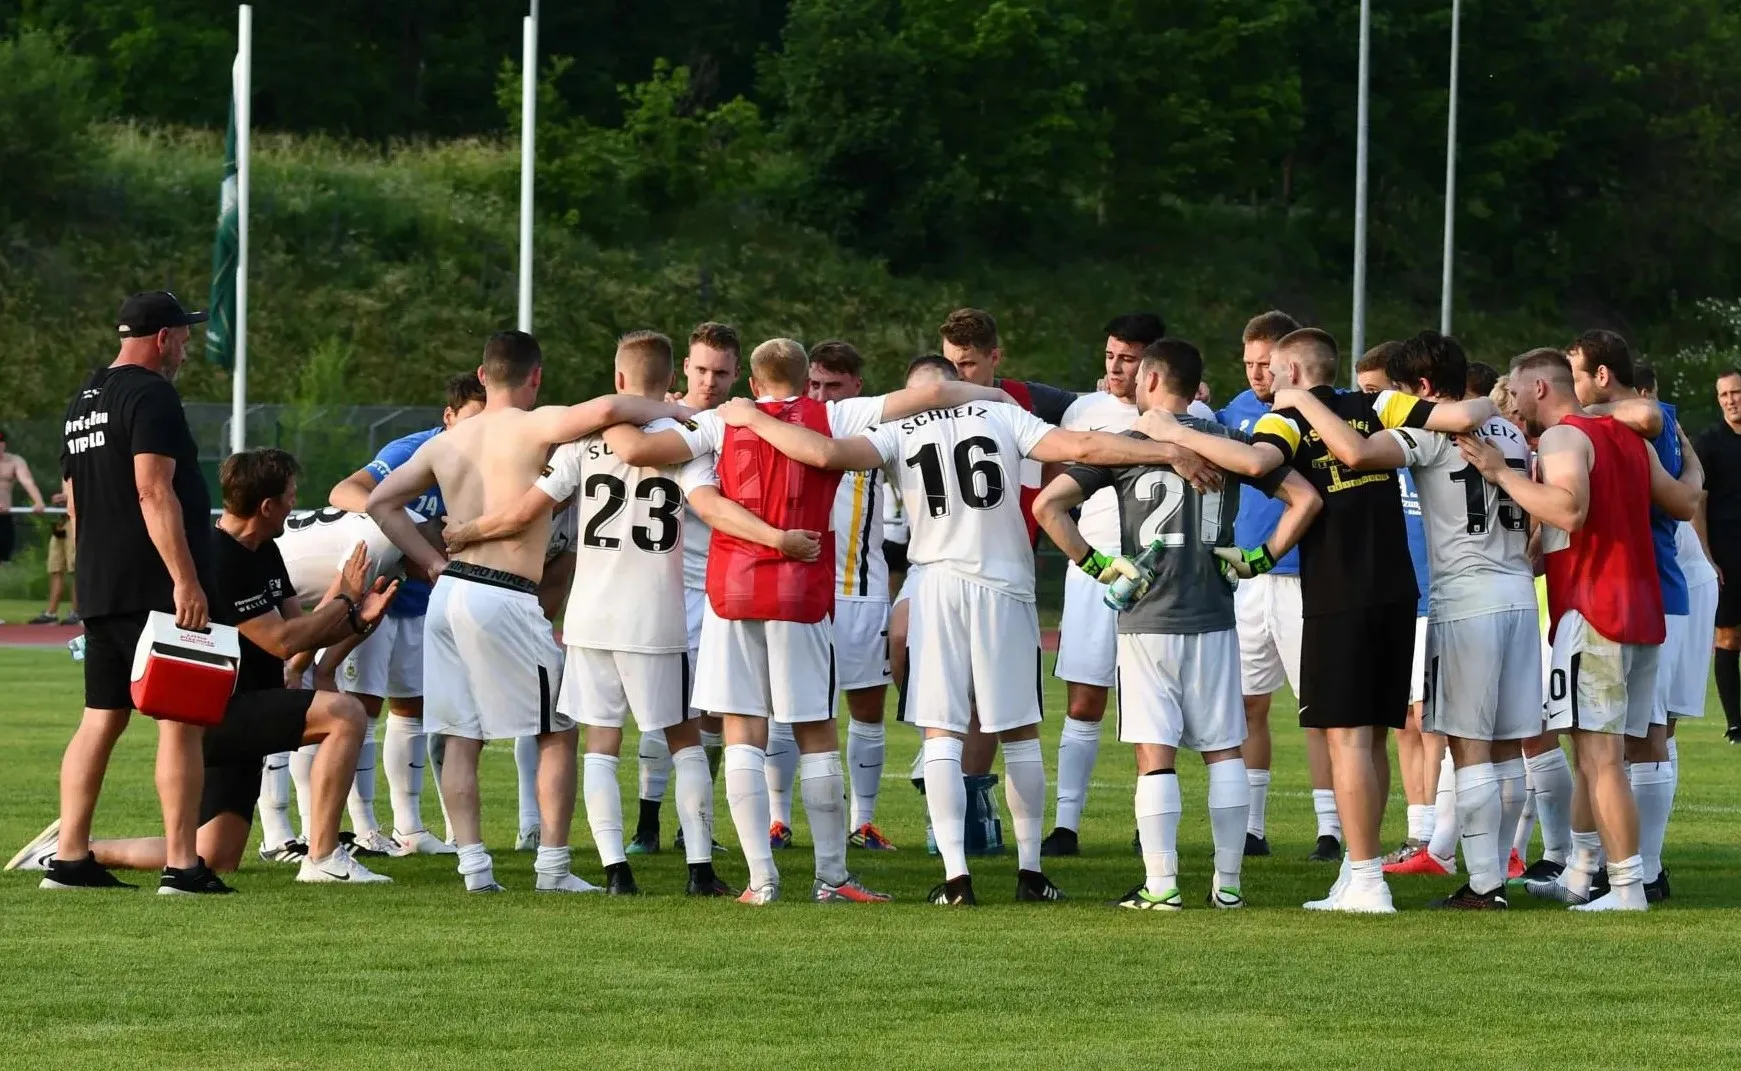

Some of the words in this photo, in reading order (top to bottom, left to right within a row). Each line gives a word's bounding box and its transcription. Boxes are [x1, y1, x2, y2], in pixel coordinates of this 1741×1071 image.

[901, 406, 988, 435] SCHLEIZ
[583, 473, 685, 554] 23
[905, 436, 1005, 519] 16
